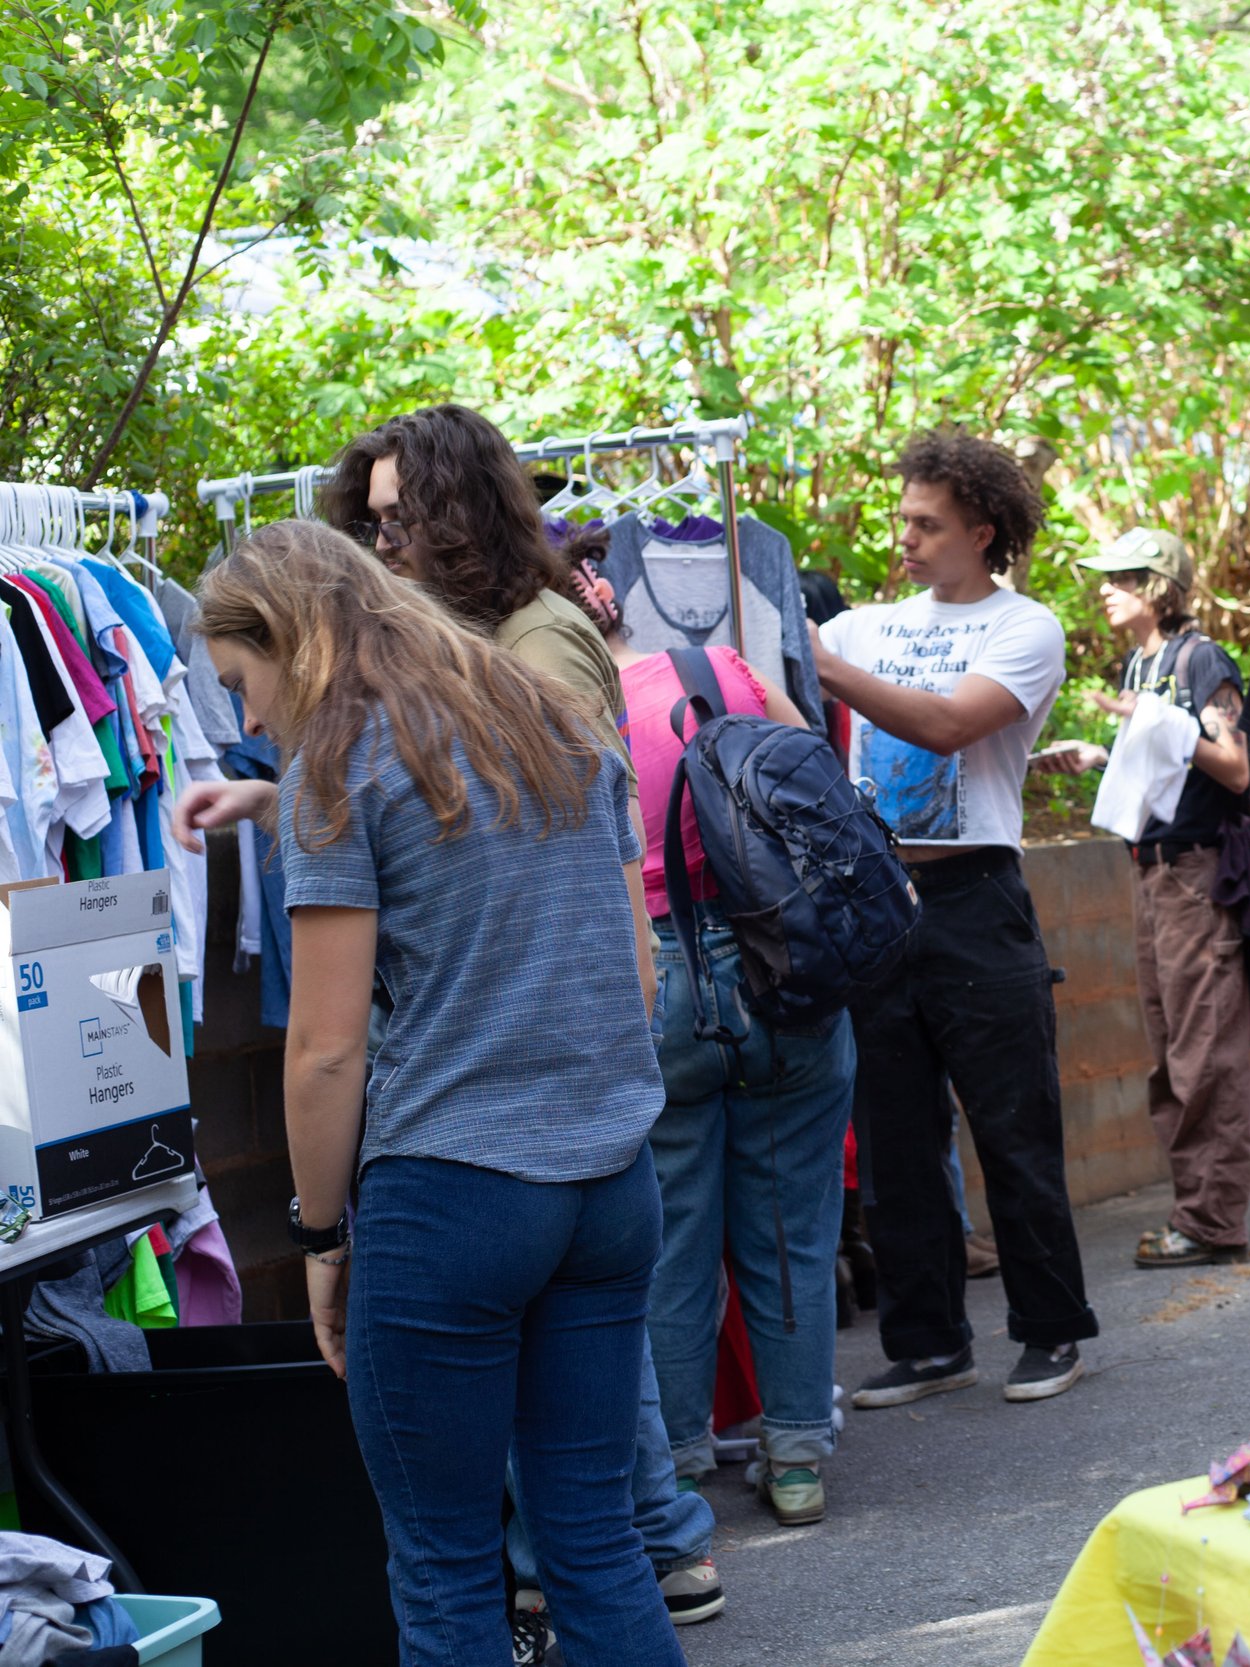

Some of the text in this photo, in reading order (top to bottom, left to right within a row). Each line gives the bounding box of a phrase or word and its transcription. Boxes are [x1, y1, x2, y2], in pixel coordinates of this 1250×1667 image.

[925, 625, 959, 638] Are
[930, 658, 969, 673] that
[88, 879, 111, 892] Plastic
[79, 894, 118, 912] Hangers
[18, 961, 44, 991] 50
[27, 994, 42, 1009] pack
[87, 1024, 129, 1043] MAINSTAYS
[96, 1061, 123, 1080] Plastic
[89, 1079, 134, 1105] Hangers
[68, 1148, 90, 1162] White
[19, 1185, 36, 1208] 50
